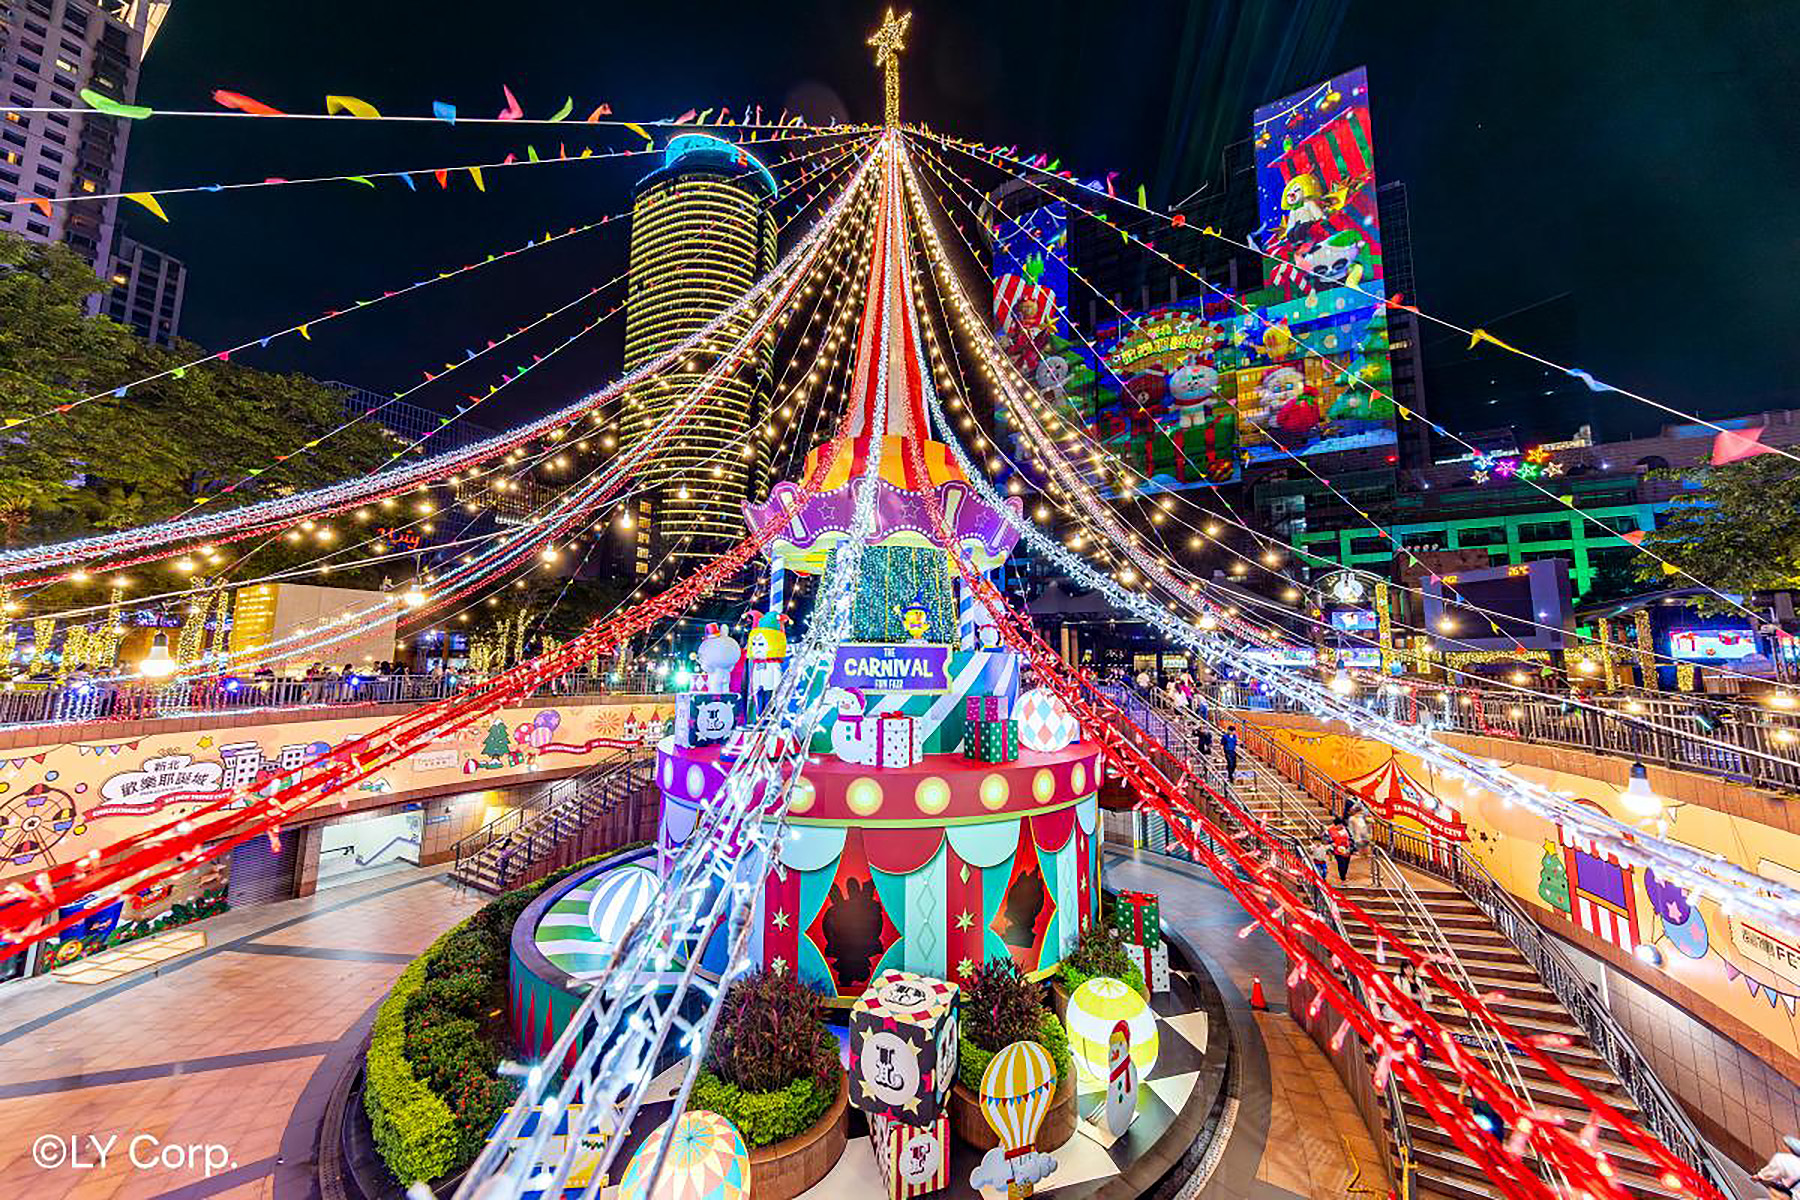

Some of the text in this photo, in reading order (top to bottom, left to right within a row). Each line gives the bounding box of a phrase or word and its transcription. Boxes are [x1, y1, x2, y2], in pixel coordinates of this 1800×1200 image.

[884, 647, 896, 658] THE
[844, 657, 934, 678] CARNIVAL
[154, 760, 180, 772] 新北
[120, 771, 210, 797] 歡樂耶誕城
[875, 1044, 905, 1091] L
